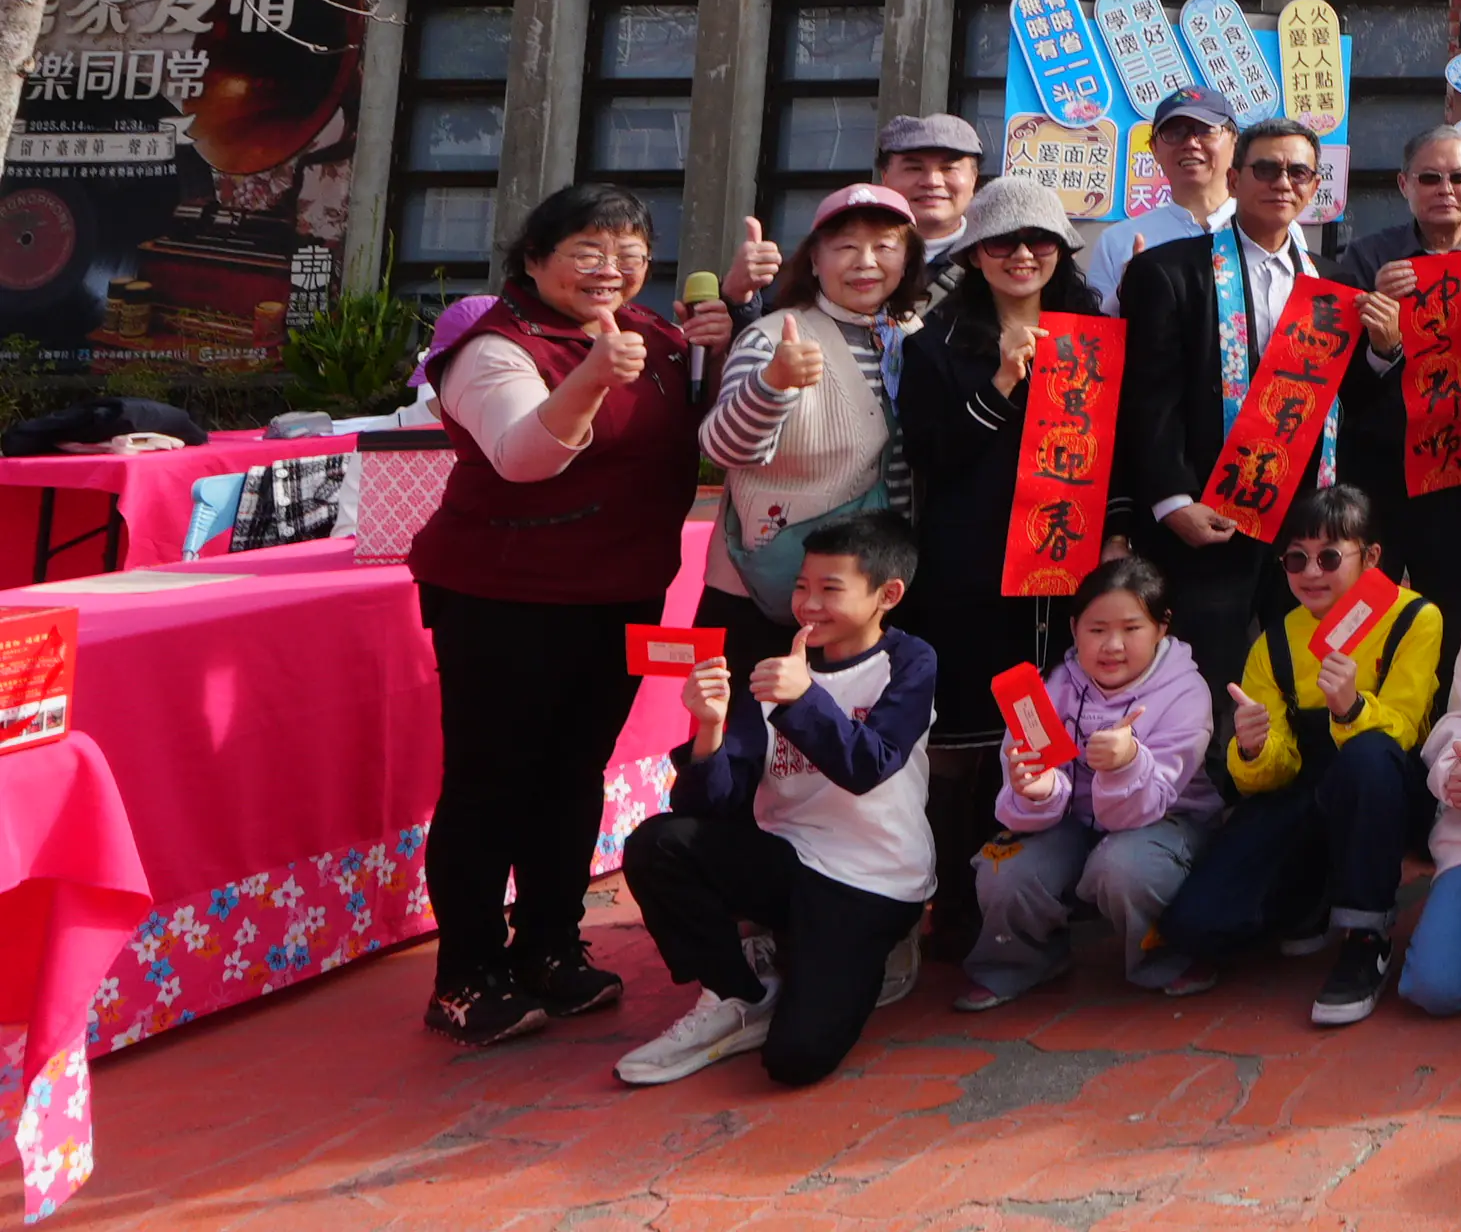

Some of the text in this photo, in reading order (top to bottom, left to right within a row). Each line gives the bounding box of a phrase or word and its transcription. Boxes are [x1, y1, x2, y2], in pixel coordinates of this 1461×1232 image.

[1103, 7, 1161, 104] 學壞三朝
[1012, 141, 1110, 166] 人愛面皮
